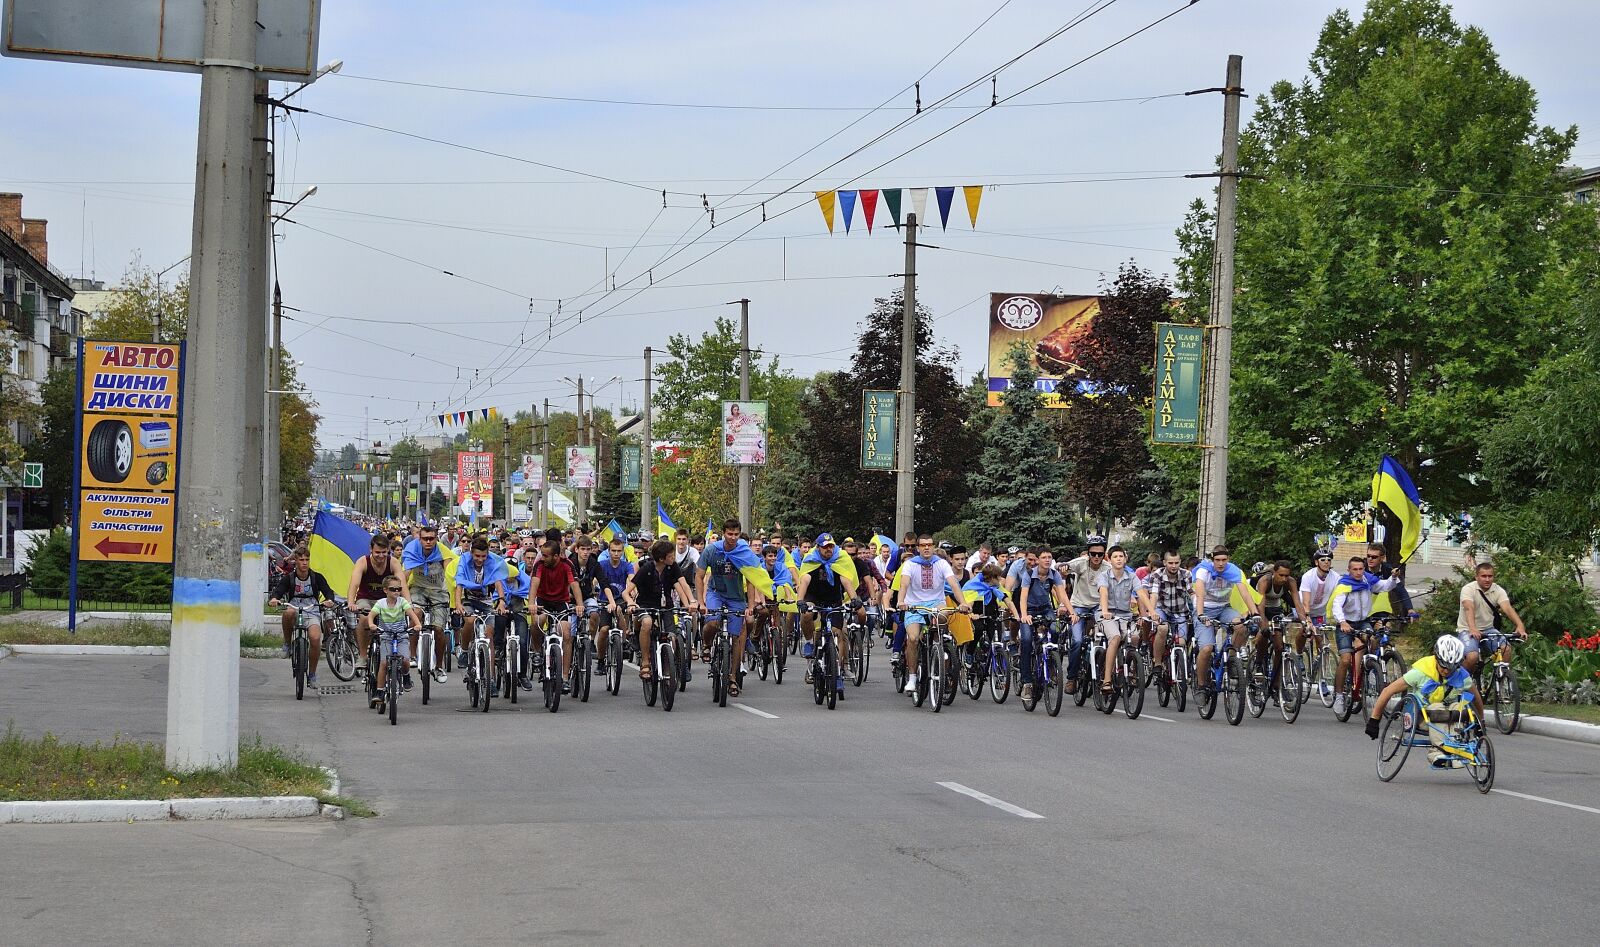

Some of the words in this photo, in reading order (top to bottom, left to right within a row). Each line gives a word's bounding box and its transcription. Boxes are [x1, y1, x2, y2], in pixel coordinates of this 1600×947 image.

[1181, 341, 1197, 349] БАР
[101, 345, 175, 369] АВТО
[93, 373, 168, 391] ШИНИ
[1159, 329, 1177, 428] АХТАМАР
[87, 391, 172, 410] ДИСКИ
[866, 395, 878, 460] АХТАМАР
[86, 494, 170, 505] АКУМУЛЯТОРИ
[103, 508, 152, 518] ФІЛЬТРИ
[91, 522, 163, 532] ЗАПЧАСТИНИ
